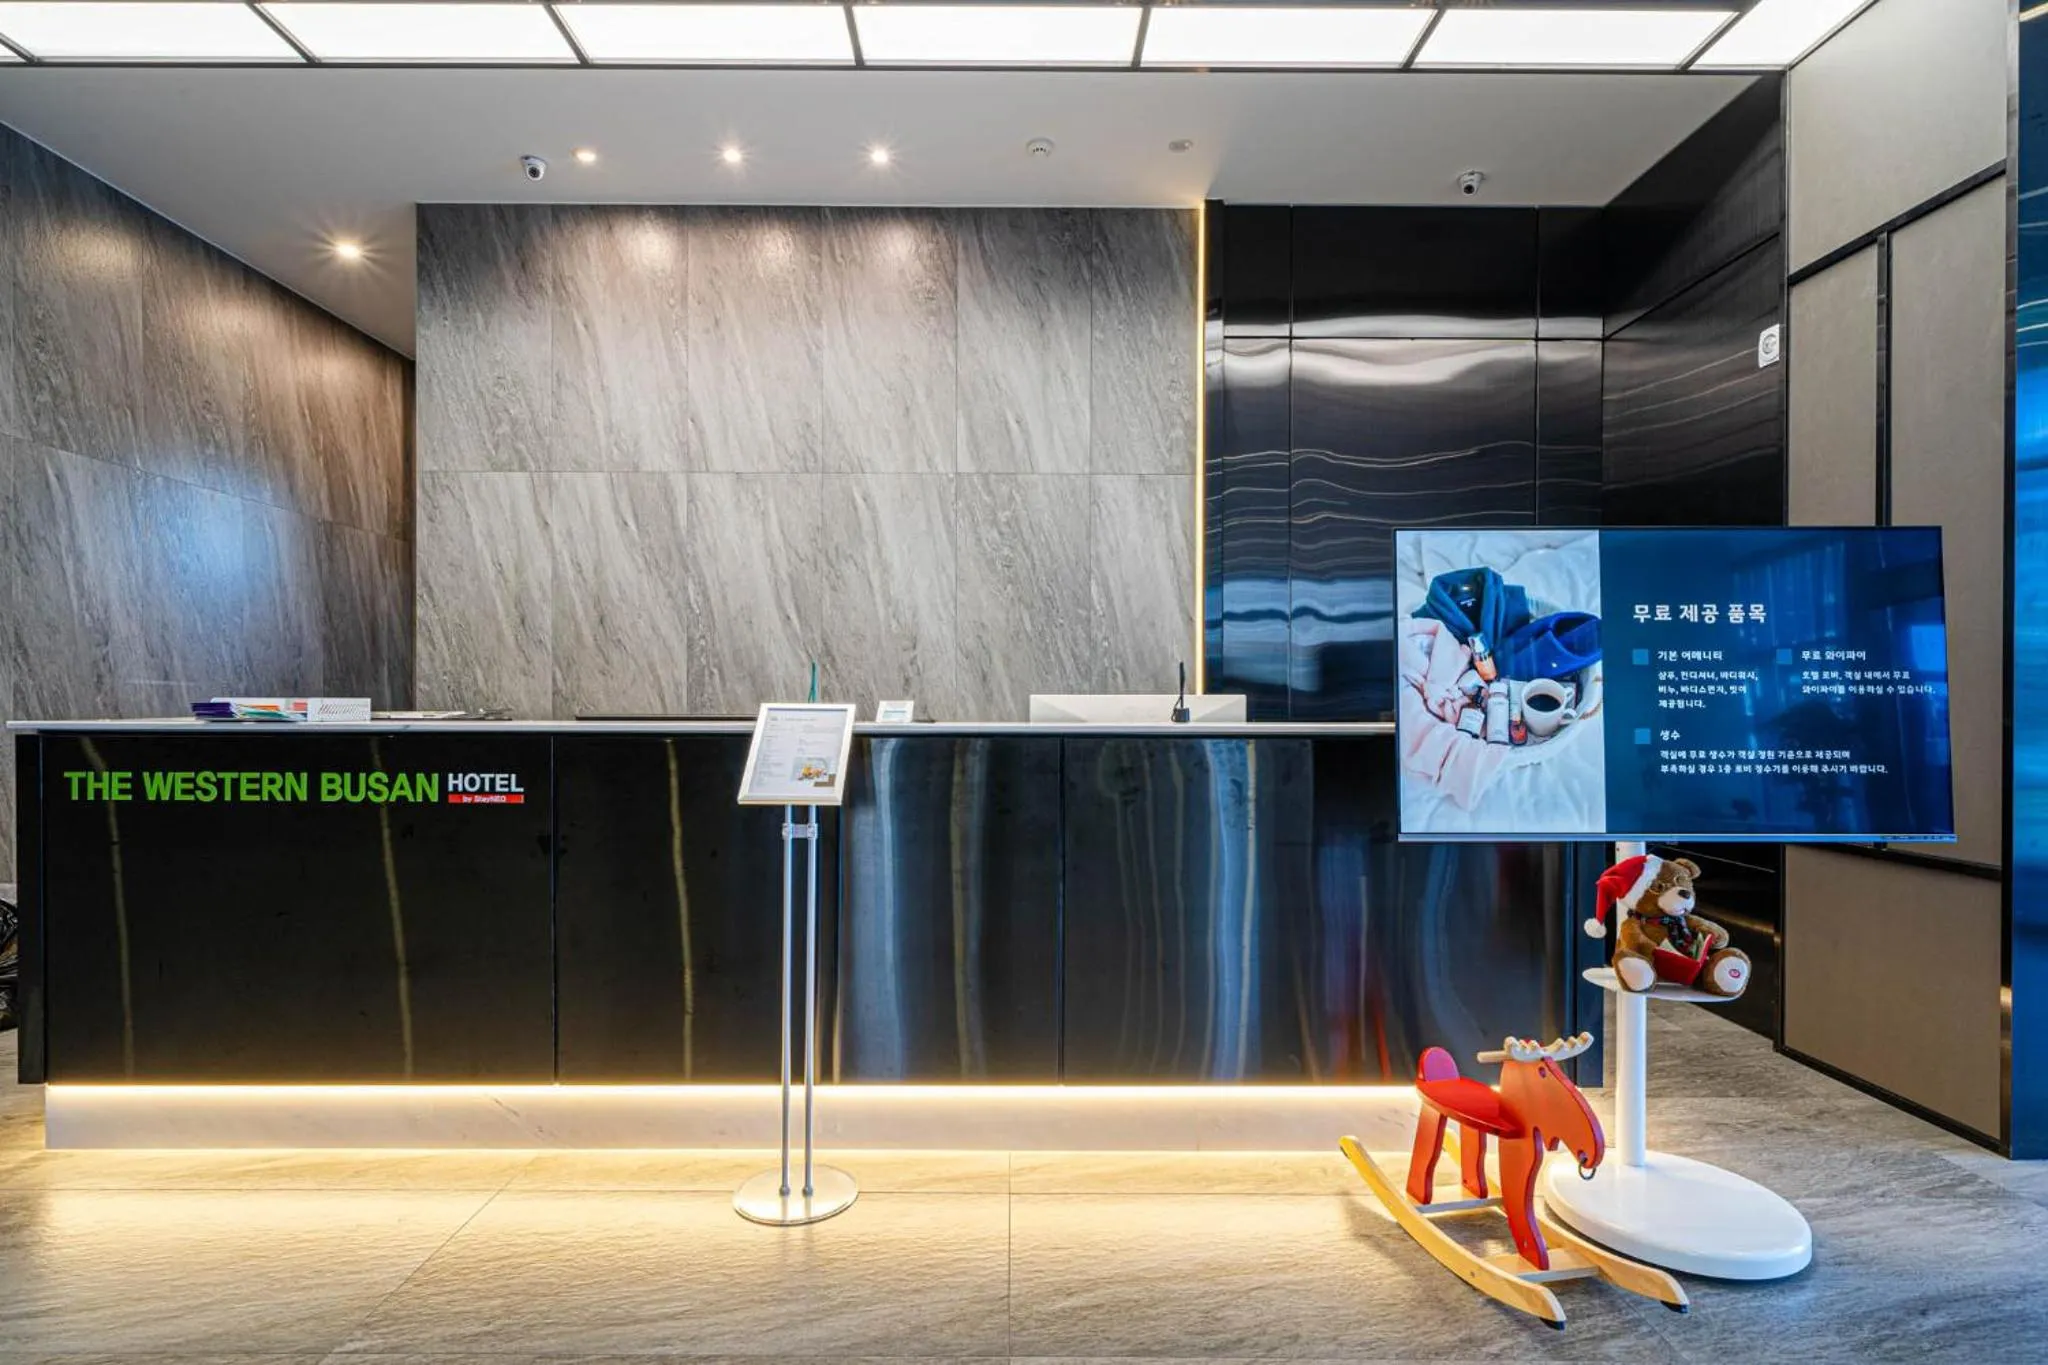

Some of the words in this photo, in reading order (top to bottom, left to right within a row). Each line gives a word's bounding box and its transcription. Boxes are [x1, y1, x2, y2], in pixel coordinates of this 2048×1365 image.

[1633, 604, 1672, 624] 무료
[1680, 604, 1720, 624] 제공
[1728, 604, 1767, 624] 품목
[1658, 650, 1678, 661] 기본
[1681, 650, 1723, 661] 어메니티
[1801, 651, 1821, 661] 무료
[1824, 651, 1866, 661] 와이파이
[1802, 671, 1819, 681] 호텔
[1844, 671, 1861, 681] 객실
[1864, 671, 1890, 681] 내에서
[1893, 671, 1910, 681] 무료
[1802, 685, 1845, 694] 와이파이를
[1848, 685, 1883, 694] 이용하실
[1886, 685, 1895, 694] 수
[1897, 685, 1936, 694] 있습니다.
[1658, 699, 1706, 709] 제공됩니다.
[1660, 730, 1680, 741] 생수
[1660, 750, 1687, 760] 객실에
[1690, 750, 1706, 760] 무료
[1709, 750, 1735, 760] 생수가
[1737, 750, 1755, 760] 객실
[1778, 750, 1813, 760] 기준으로
[1698, 764, 1715, 774] 경우
[1719, 764, 1731, 774] 1층
[1792, 764, 1818, 774] 이용해
[1821, 764, 1847, 774] 주시기
[1850, 764, 1888, 774] 바랍니다.
[64, 771, 132, 801] THE
[143, 771, 308, 802] WESTERN
[320, 772, 439, 803] BUSAN
[447, 773, 524, 792] HOTEL
